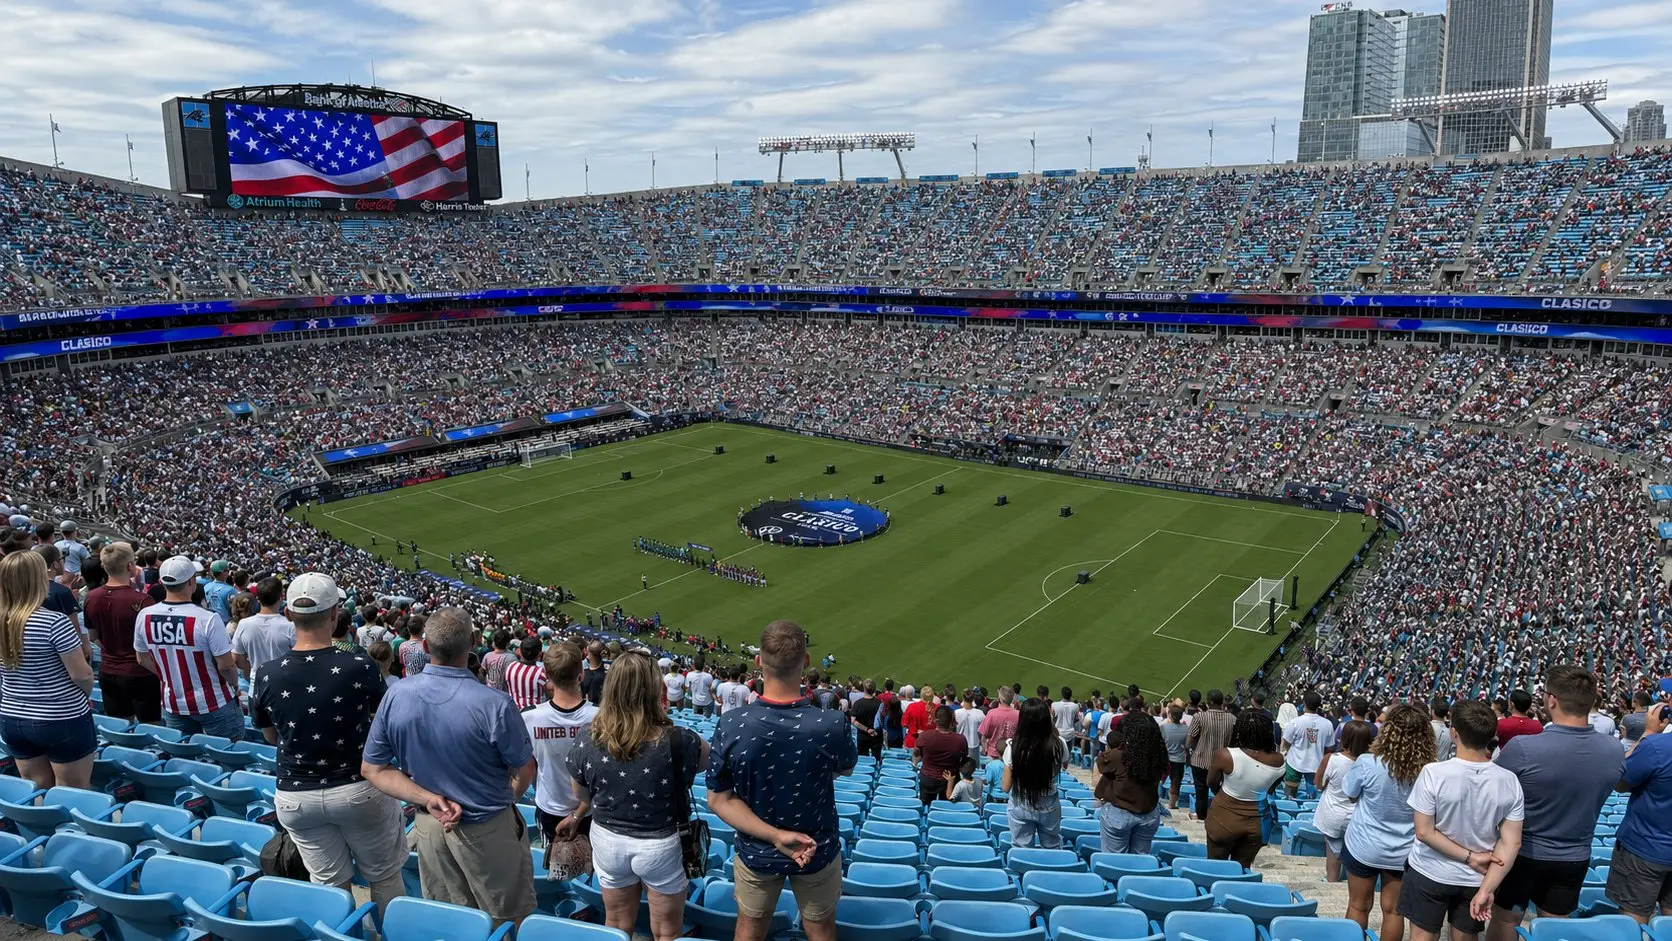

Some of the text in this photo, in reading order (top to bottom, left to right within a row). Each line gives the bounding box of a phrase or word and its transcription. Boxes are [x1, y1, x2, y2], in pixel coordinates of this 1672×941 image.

[246, 197, 322, 208] Atrium Health
[435, 202, 463, 211] Harris
[1541, 298, 1612, 310] CLASICO
[150, 621, 188, 645] USA
